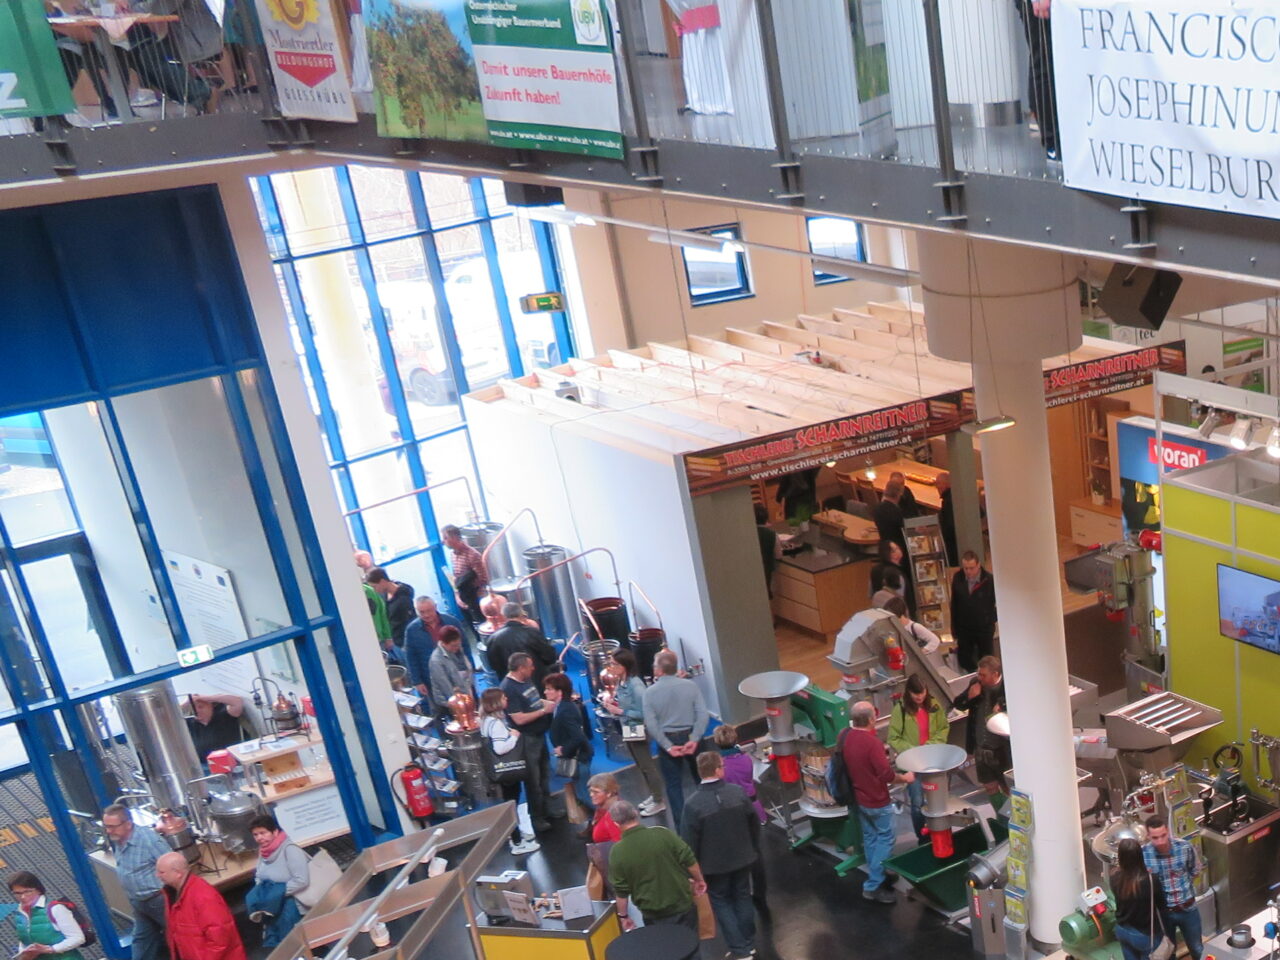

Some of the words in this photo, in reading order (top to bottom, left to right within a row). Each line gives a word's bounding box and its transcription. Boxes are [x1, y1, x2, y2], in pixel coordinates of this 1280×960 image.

[277, 54, 334, 69] BILDUNGSHOF
[482, 61, 510, 78] Damit
[512, 65, 548, 79] unsere
[550, 65, 614, 85] Bauernhöfe
[485, 85, 523, 102] Zukunft
[525, 90, 561, 105] haben!
[1050, 349, 1160, 389] SCHARNREITNER
[723, 438, 794, 466] TISCHLEREI
[795, 401, 929, 448] SCHARNREITNER
[749, 434, 913, 482] www.tischlerei-scharnreitner.at
[1153, 444, 1200, 468] voran
